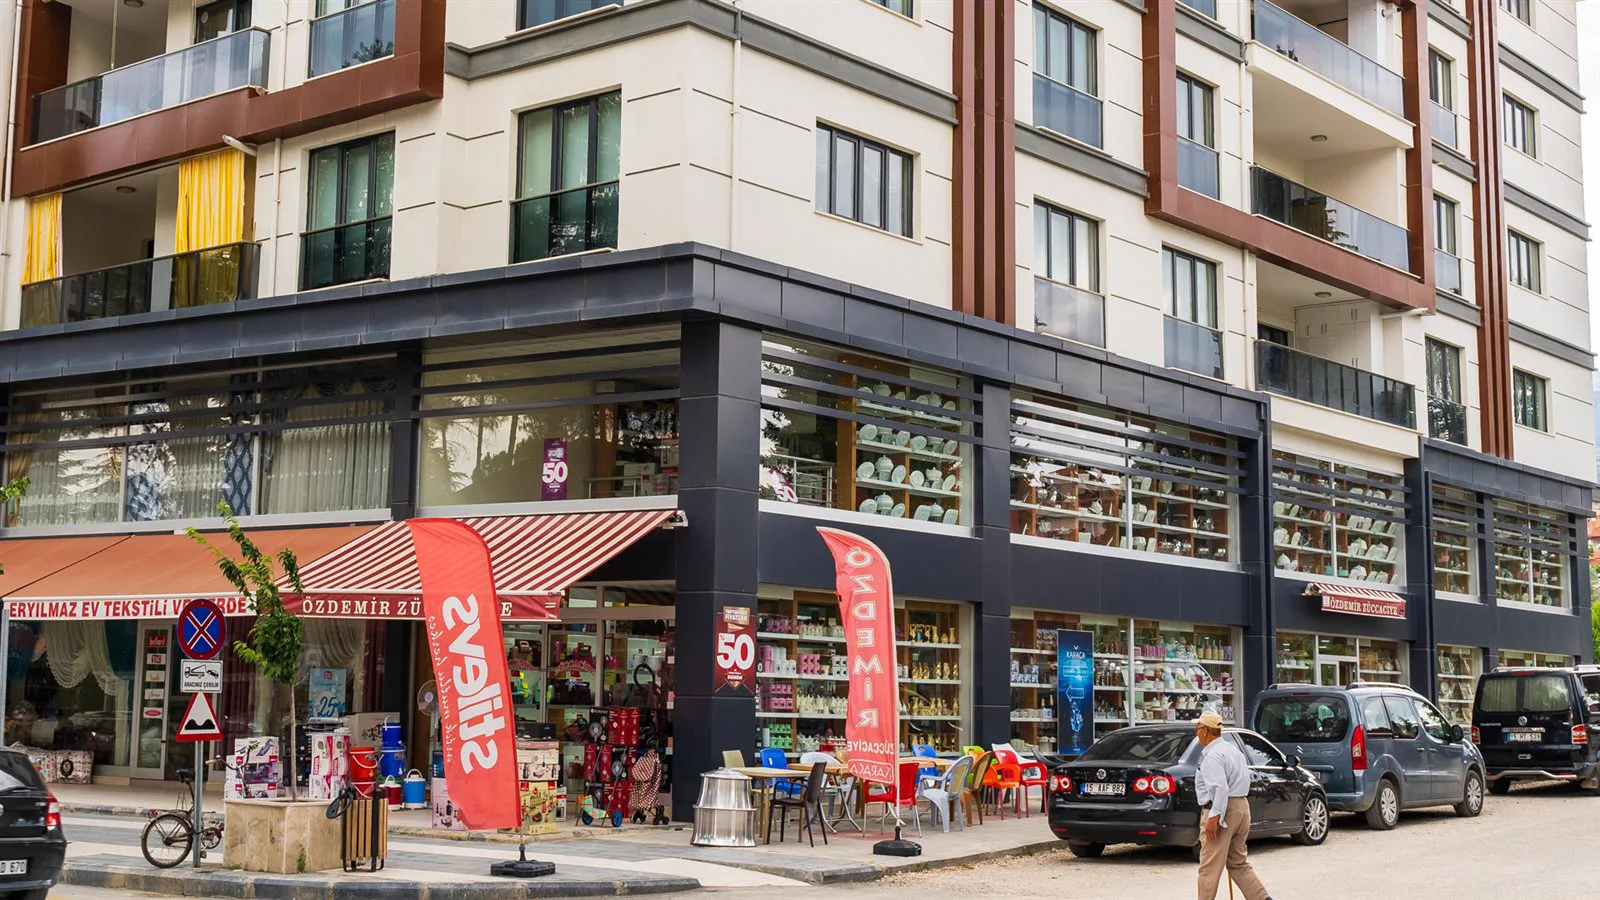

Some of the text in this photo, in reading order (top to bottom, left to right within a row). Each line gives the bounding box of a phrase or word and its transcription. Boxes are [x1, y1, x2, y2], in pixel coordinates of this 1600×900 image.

[9, 602, 77, 618] ERYILMAZ
[82, 601, 100, 617] EV
[303, 596, 390, 616] ÖZDEMİR
[1330, 597, 1398, 615] ÖZDEMİR ZÜCCACİYE
[1066, 651, 1086, 659] KARACA
[1086, 783, 1093, 792] 15
